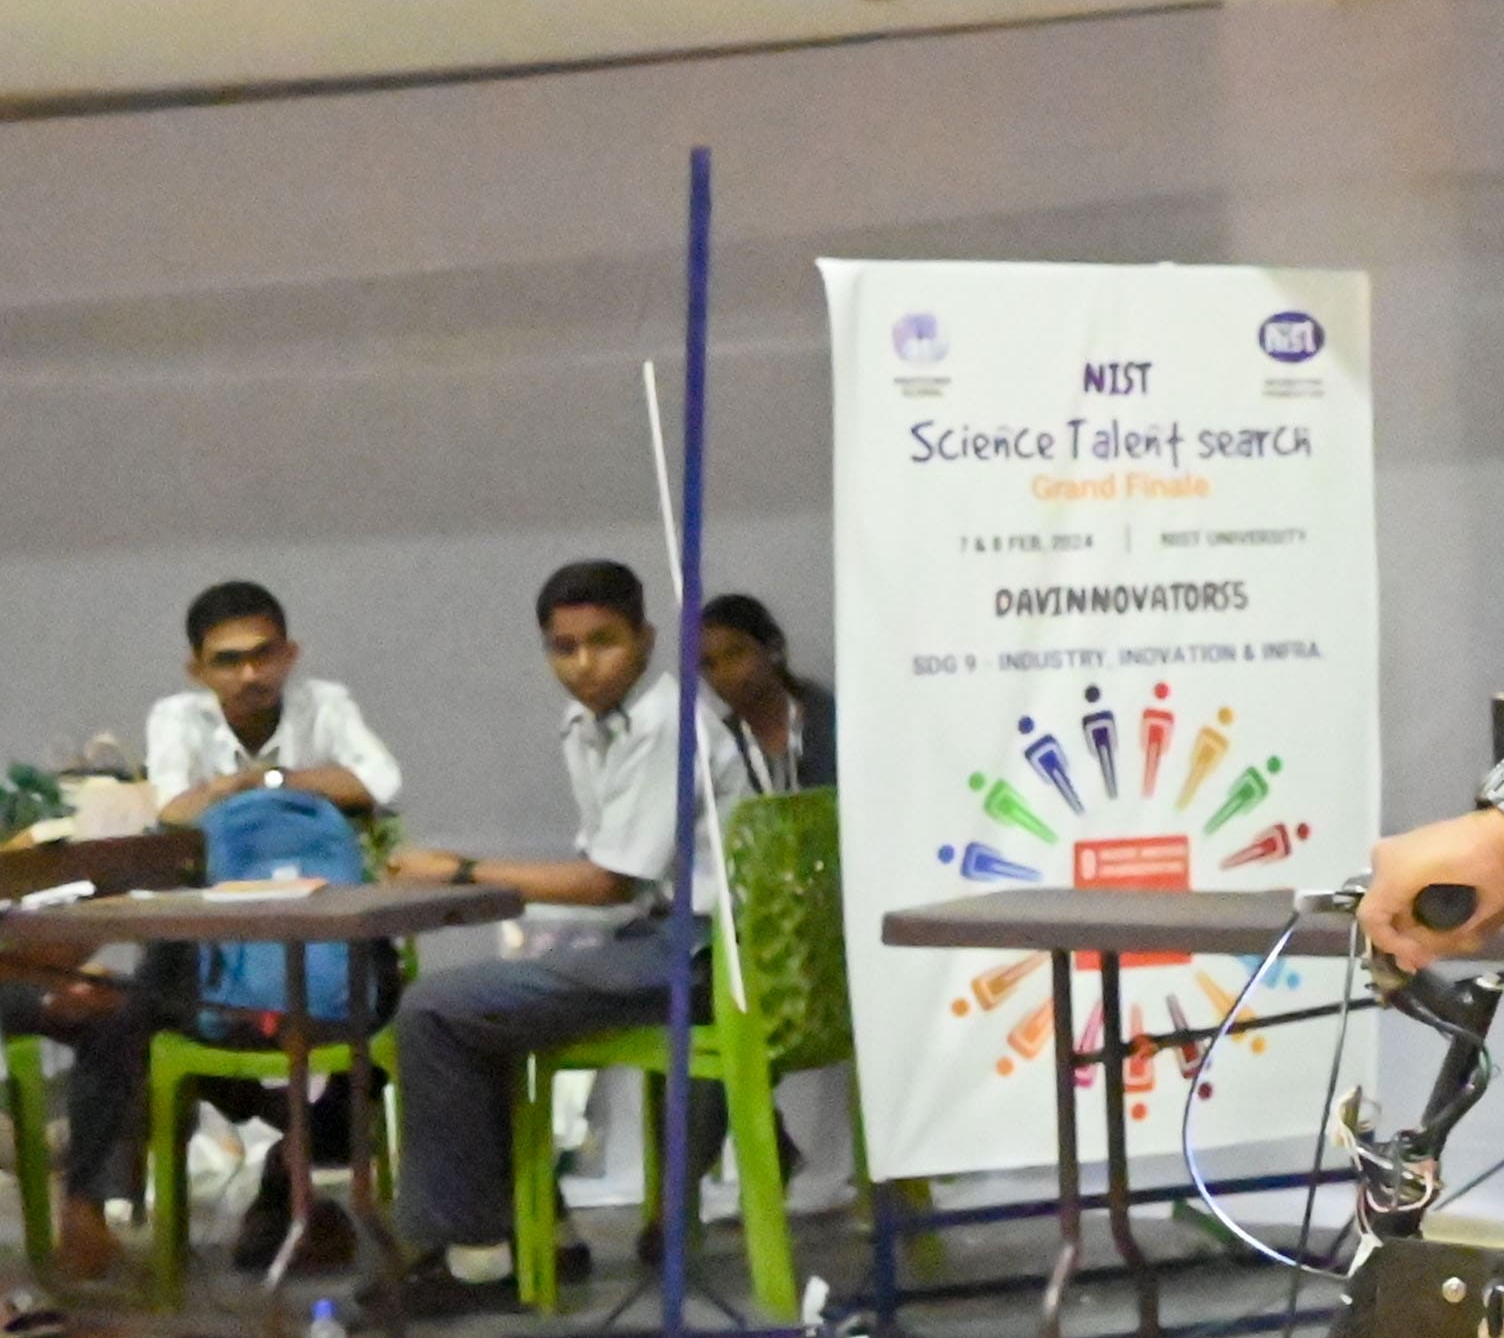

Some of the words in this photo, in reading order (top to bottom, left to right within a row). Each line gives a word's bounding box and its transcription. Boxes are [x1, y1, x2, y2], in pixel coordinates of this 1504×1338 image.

[1082, 361, 1153, 396] NIST
[909, 419, 1056, 463] Science
[1067, 418, 1184, 468] Talent
[1198, 426, 1313, 461] search
[1030, 473, 1118, 503] Grand
[1125, 472, 1212, 500] Finale
[912, 652, 958, 676] SDG
